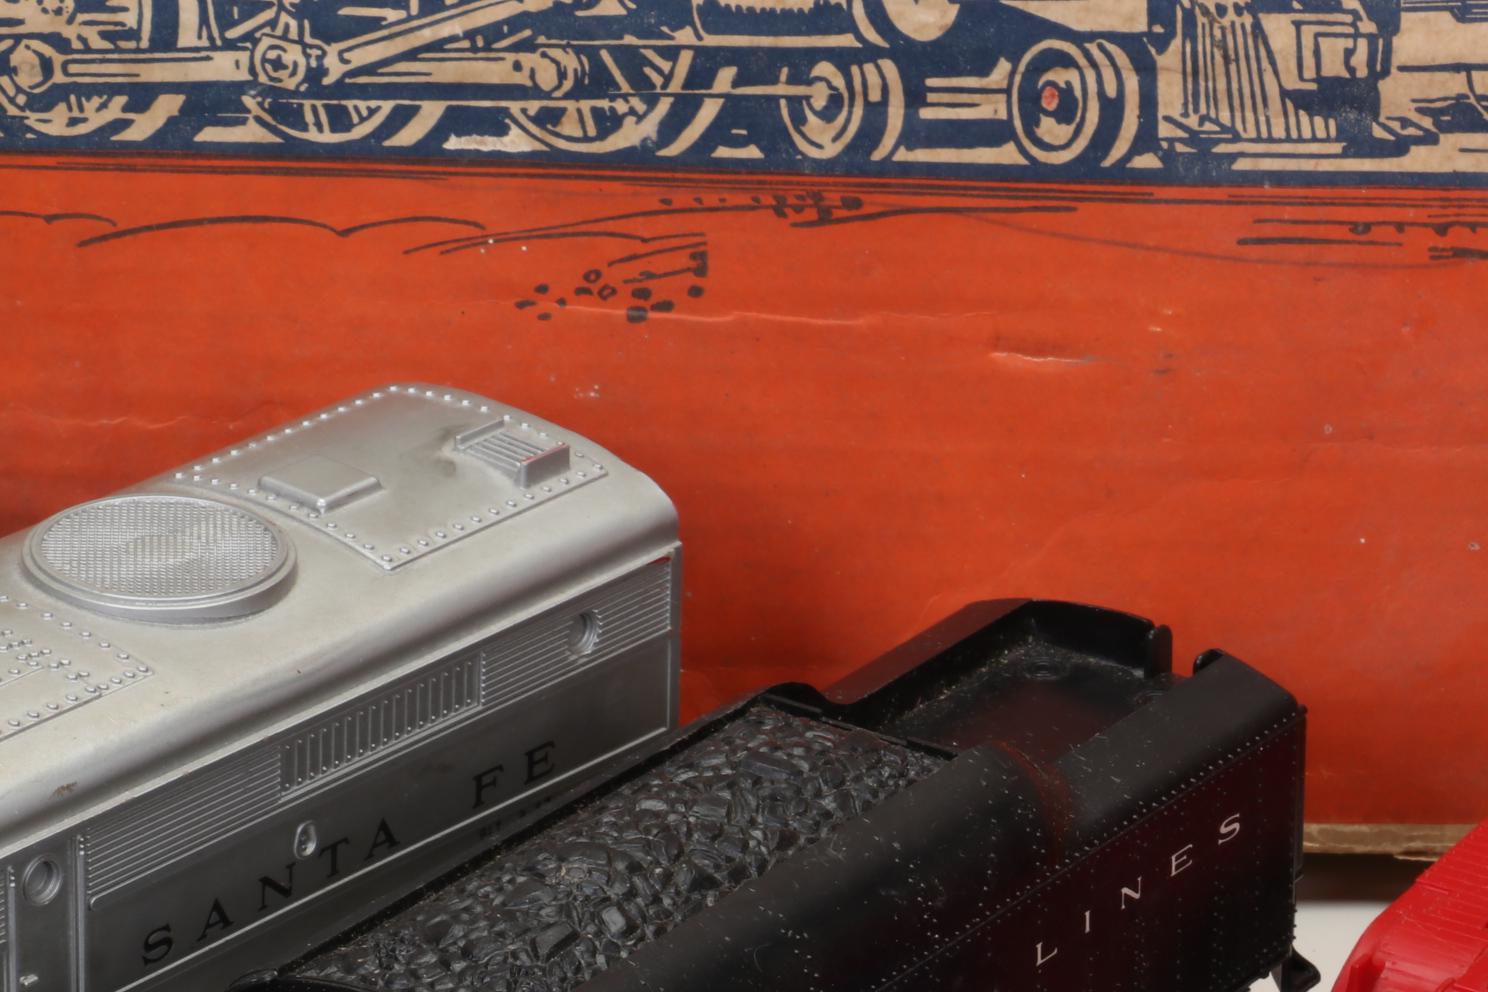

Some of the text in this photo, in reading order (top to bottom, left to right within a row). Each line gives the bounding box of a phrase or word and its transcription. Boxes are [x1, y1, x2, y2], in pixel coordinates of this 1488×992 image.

[140, 740, 559, 967] SANTA FE
[1035, 812, 1242, 967] LINES
